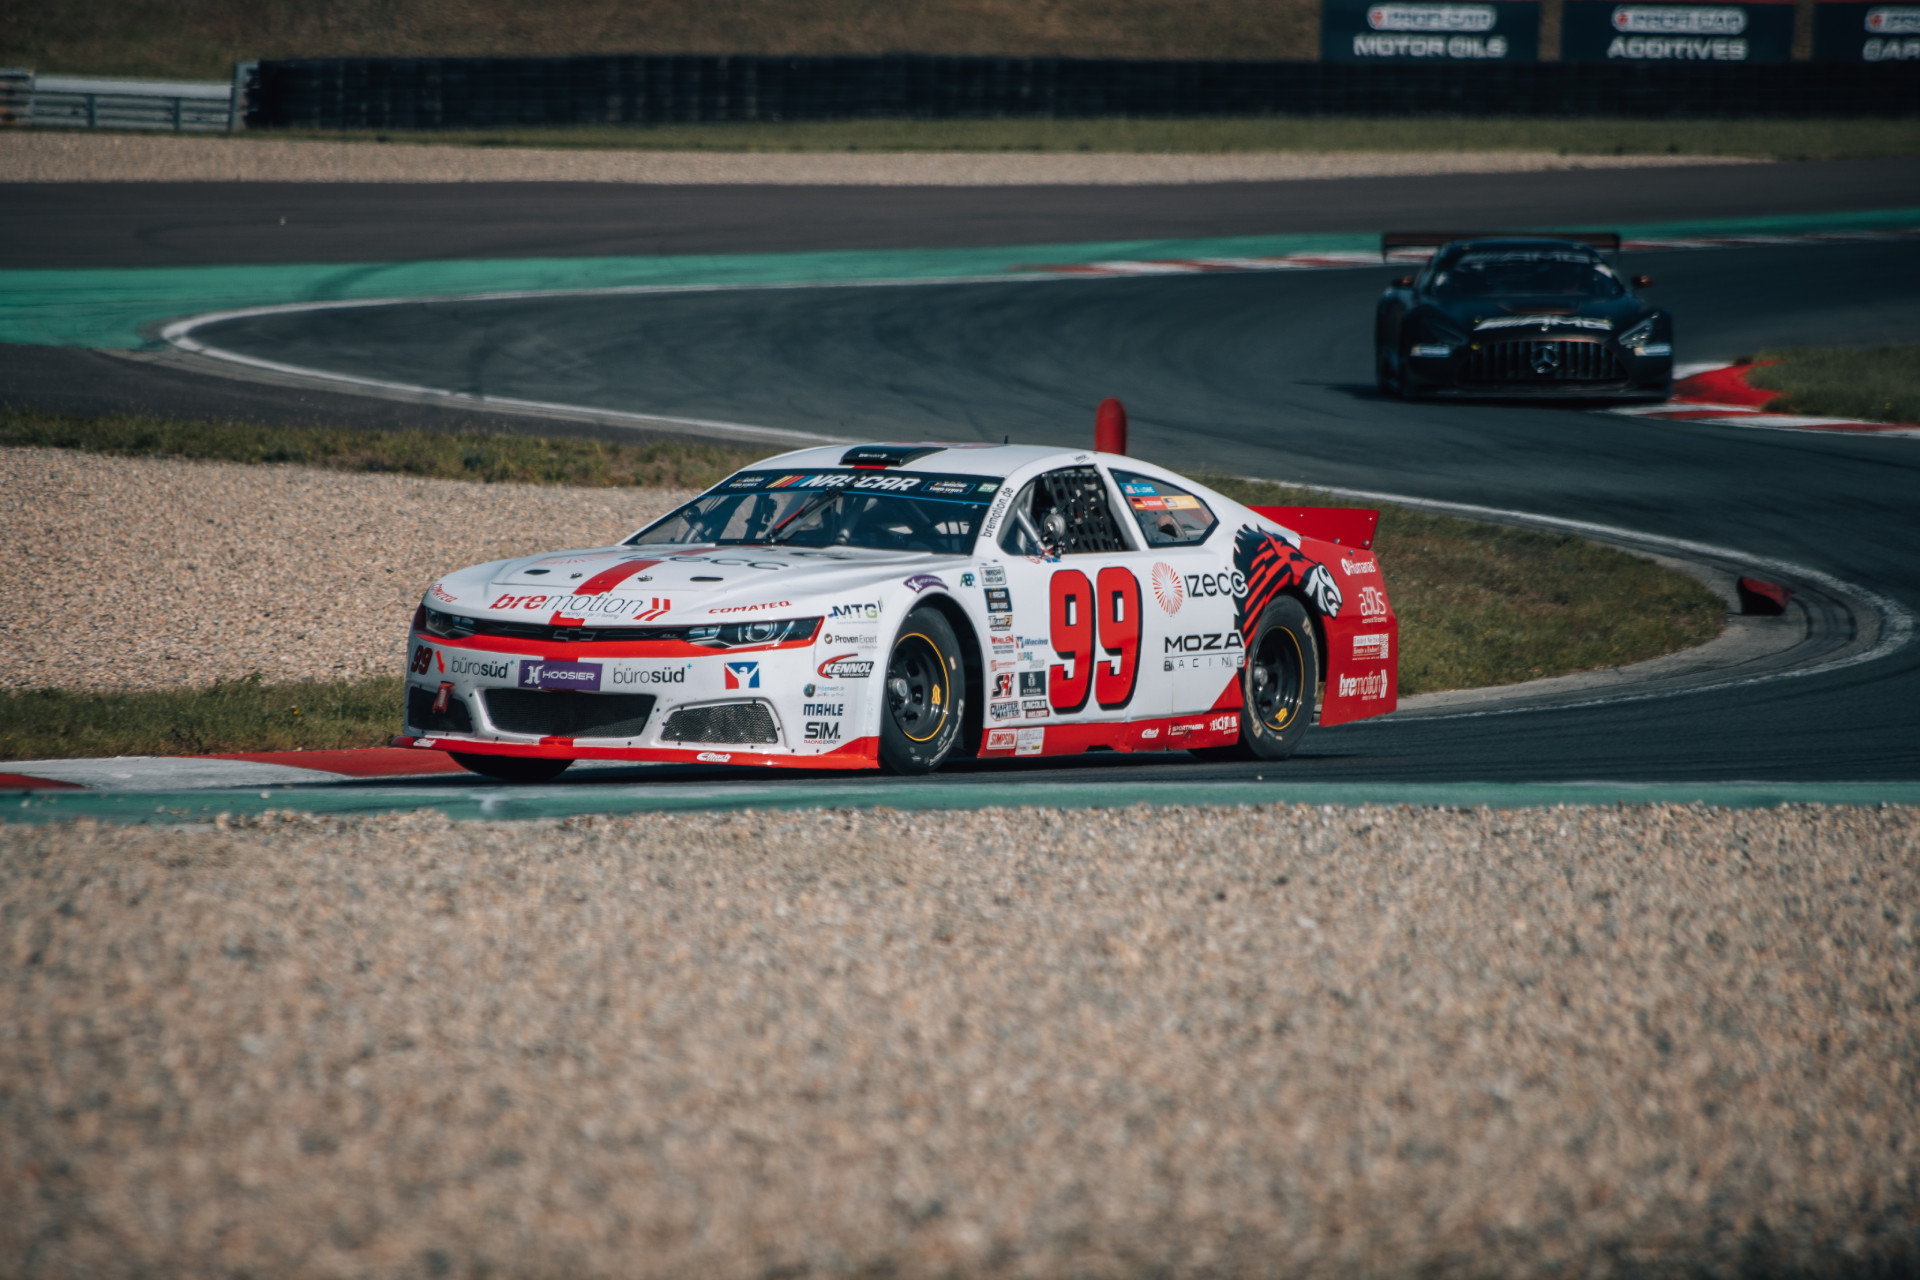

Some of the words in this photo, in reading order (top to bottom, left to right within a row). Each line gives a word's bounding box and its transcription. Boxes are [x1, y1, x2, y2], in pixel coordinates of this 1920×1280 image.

[1353, 36, 1445, 57] MOTOR
[1449, 36, 1507, 59] OILS
[1607, 37, 1746, 61] ADDITIVES
[980, 487, 1014, 538] bremotion.de
[489, 592, 644, 615] bremotion
[708, 600, 792, 614] COMATEQ
[1049, 566, 1144, 715] 99
[1164, 633, 1244, 653] MOZA
[411, 645, 433, 675] 99
[451, 656, 509, 679] bürosüd
[823, 662, 873, 674] KENNOL
[542, 670, 595, 681] HOOSIER
[613, 666, 685, 684] bürosüd
[1339, 670, 1381, 698] bremotion
[803, 703, 844, 717] MAHLE
[991, 702, 1018, 715] QUARTER
[995, 709, 1019, 719] MASTER
[991, 733, 1016, 746] SIMPSON
